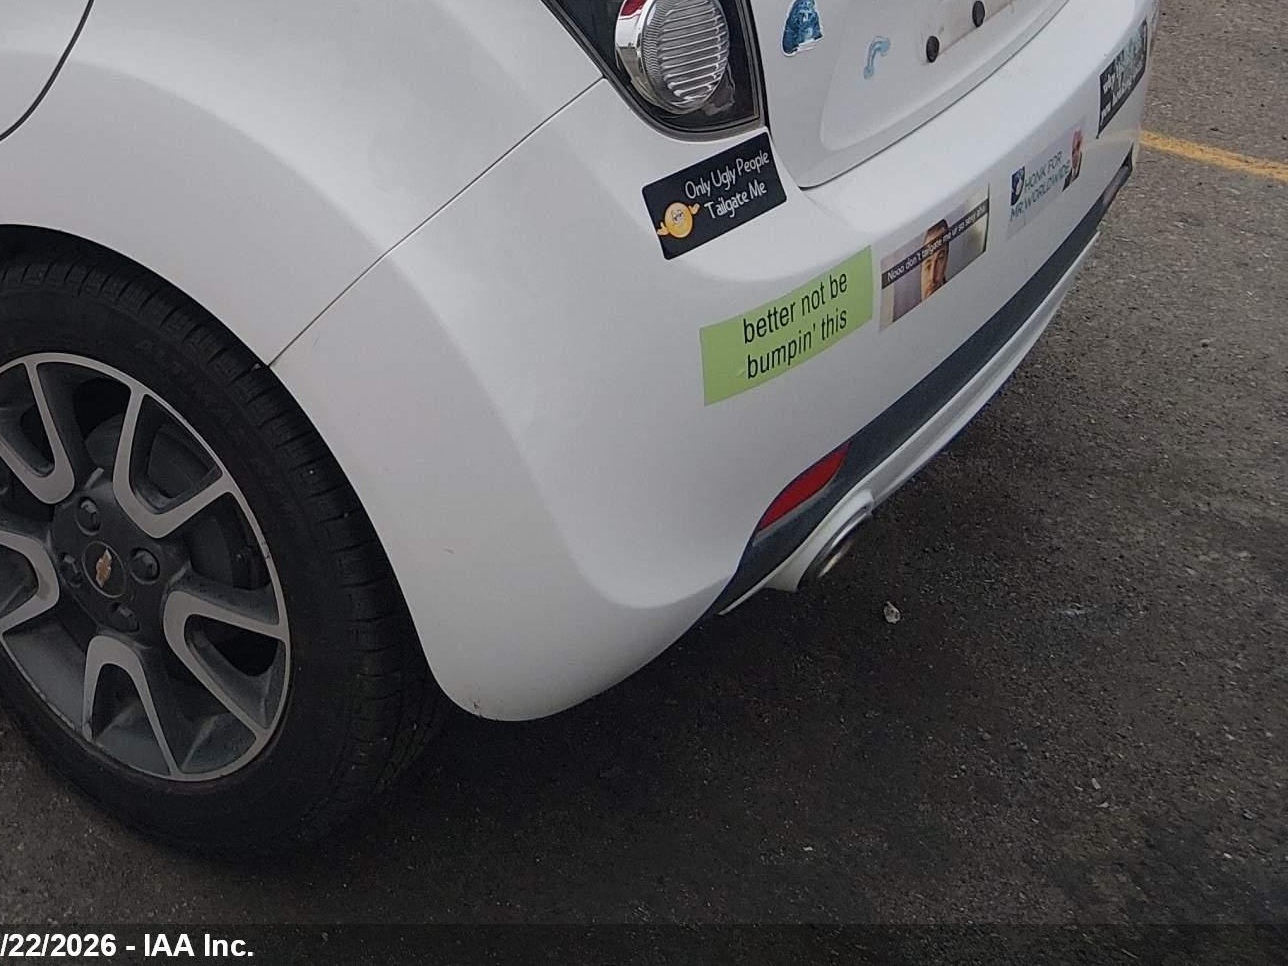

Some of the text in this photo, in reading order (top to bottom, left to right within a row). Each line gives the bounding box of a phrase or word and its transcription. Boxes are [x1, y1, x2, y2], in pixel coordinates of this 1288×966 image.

[685, 150, 770, 199] Only Ugly People
[1047, 150, 1063, 173] FOR
[704, 178, 767, 219] Tailgate Me
[743, 272, 848, 345] better not be
[746, 307, 848, 380] bumpin' this
